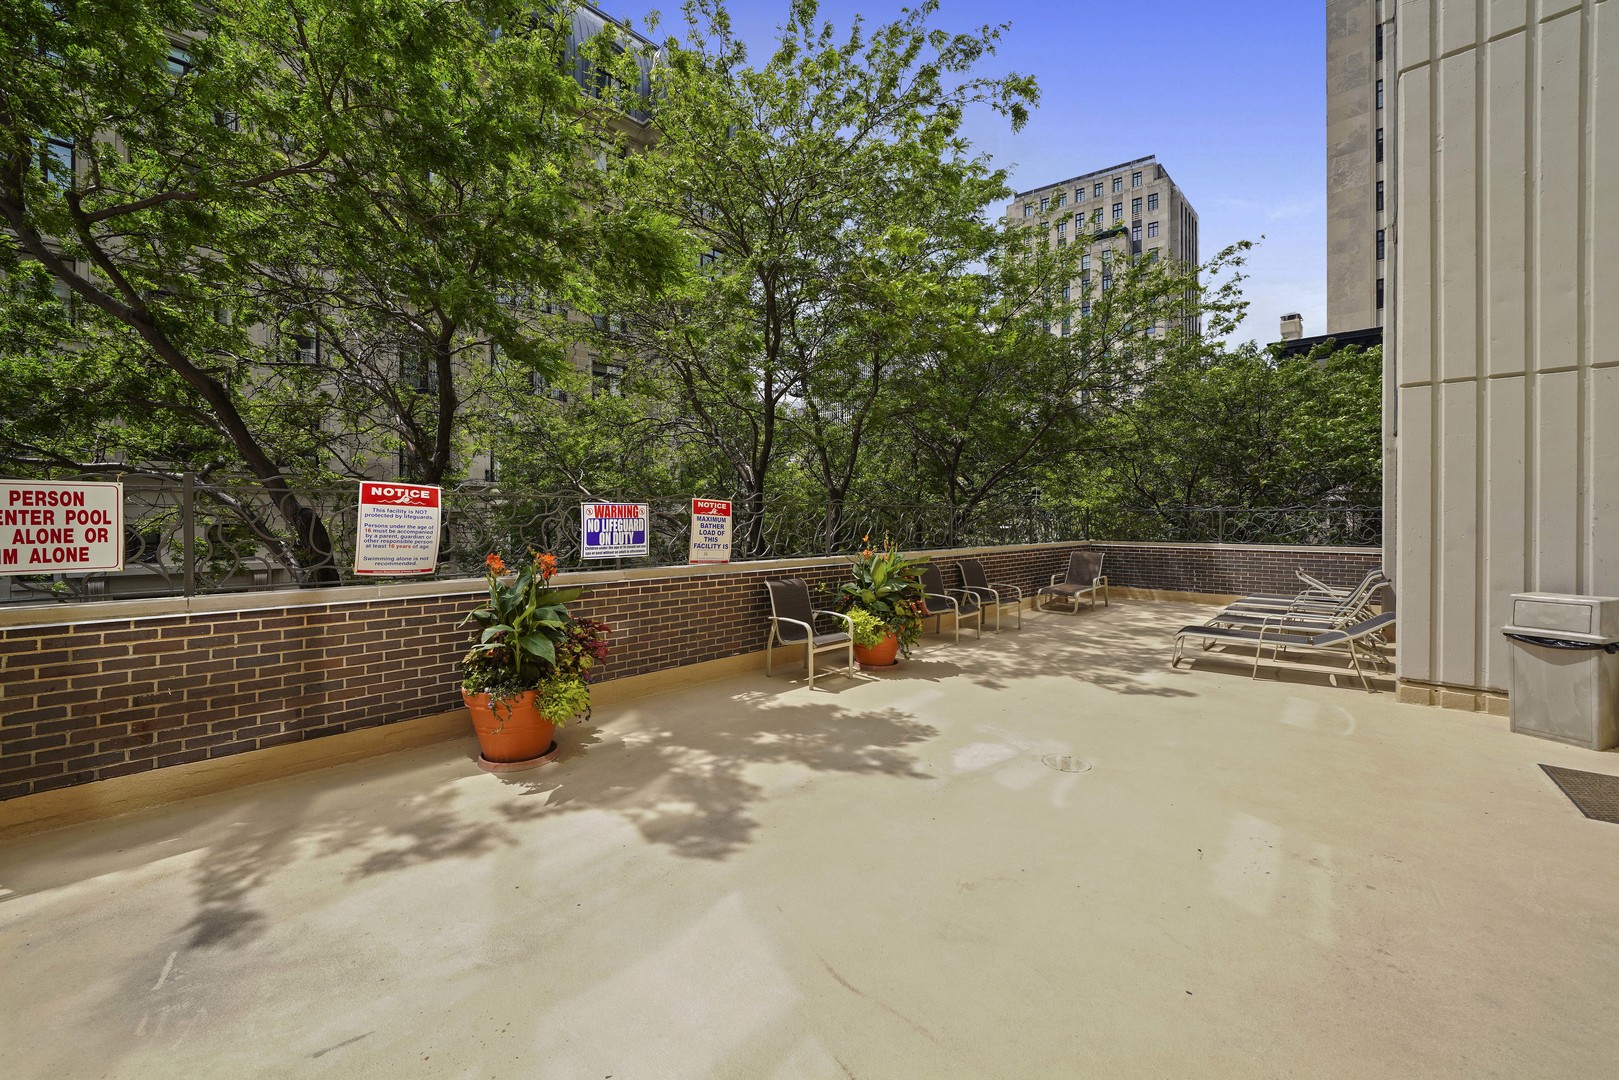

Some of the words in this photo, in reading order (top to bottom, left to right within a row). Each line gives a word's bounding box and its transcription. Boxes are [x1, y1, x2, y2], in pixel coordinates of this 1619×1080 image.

[9, 490, 84, 506] PERSON
[371, 487, 430, 498] NOTICE
[594, 505, 638, 518] WARNING
[698, 501, 727, 509] NOTICE
[0, 509, 54, 525] NTER
[65, 509, 111, 525] POOL
[696, 515, 727, 523] MAXIMUM
[588, 519, 600, 532] NO
[602, 519, 644, 532] LIFEGUARD
[12, 528, 74, 544] ALONE
[84, 527, 108, 543] OR
[599, 531, 611, 546] ON
[613, 532, 634, 545] DUTY
[0, 548, 17, 564] M
[29, 546, 89, 563] ALONE
